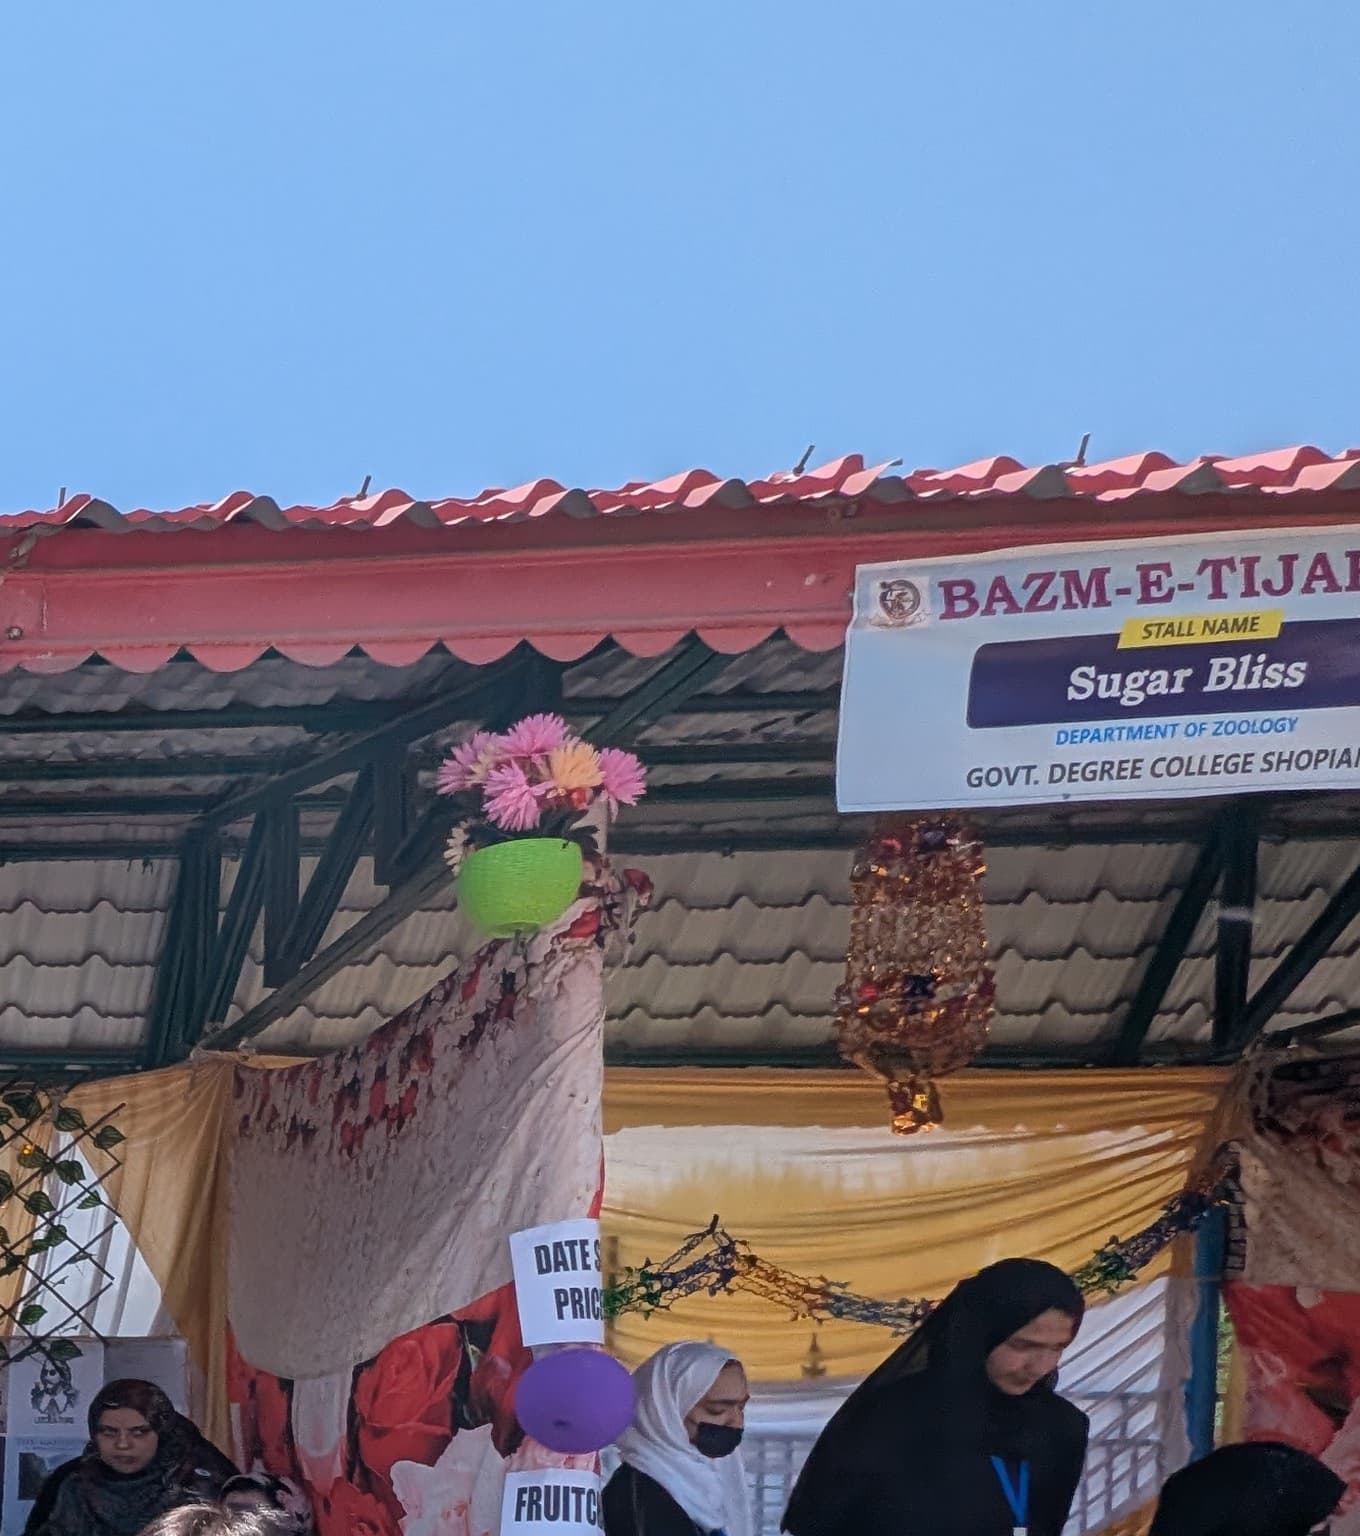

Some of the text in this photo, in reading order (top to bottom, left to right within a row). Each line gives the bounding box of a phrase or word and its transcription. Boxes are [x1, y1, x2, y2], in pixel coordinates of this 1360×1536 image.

[1142, 616, 1261, 640] STALL NAME
[1067, 653, 1308, 706] Sugar Bliss
[1055, 717, 1300, 746] DEPARTMENT OF ZOOLOGY
[966, 764, 1040, 789] GOVT.
[1047, 757, 1145, 785] DEGREE
[1149, 752, 1255, 779] COLLEGE
[533, 1239, 591, 1276] DATE
[553, 1287, 603, 1322] PRIC
[514, 1486, 600, 1528] FRUITC
